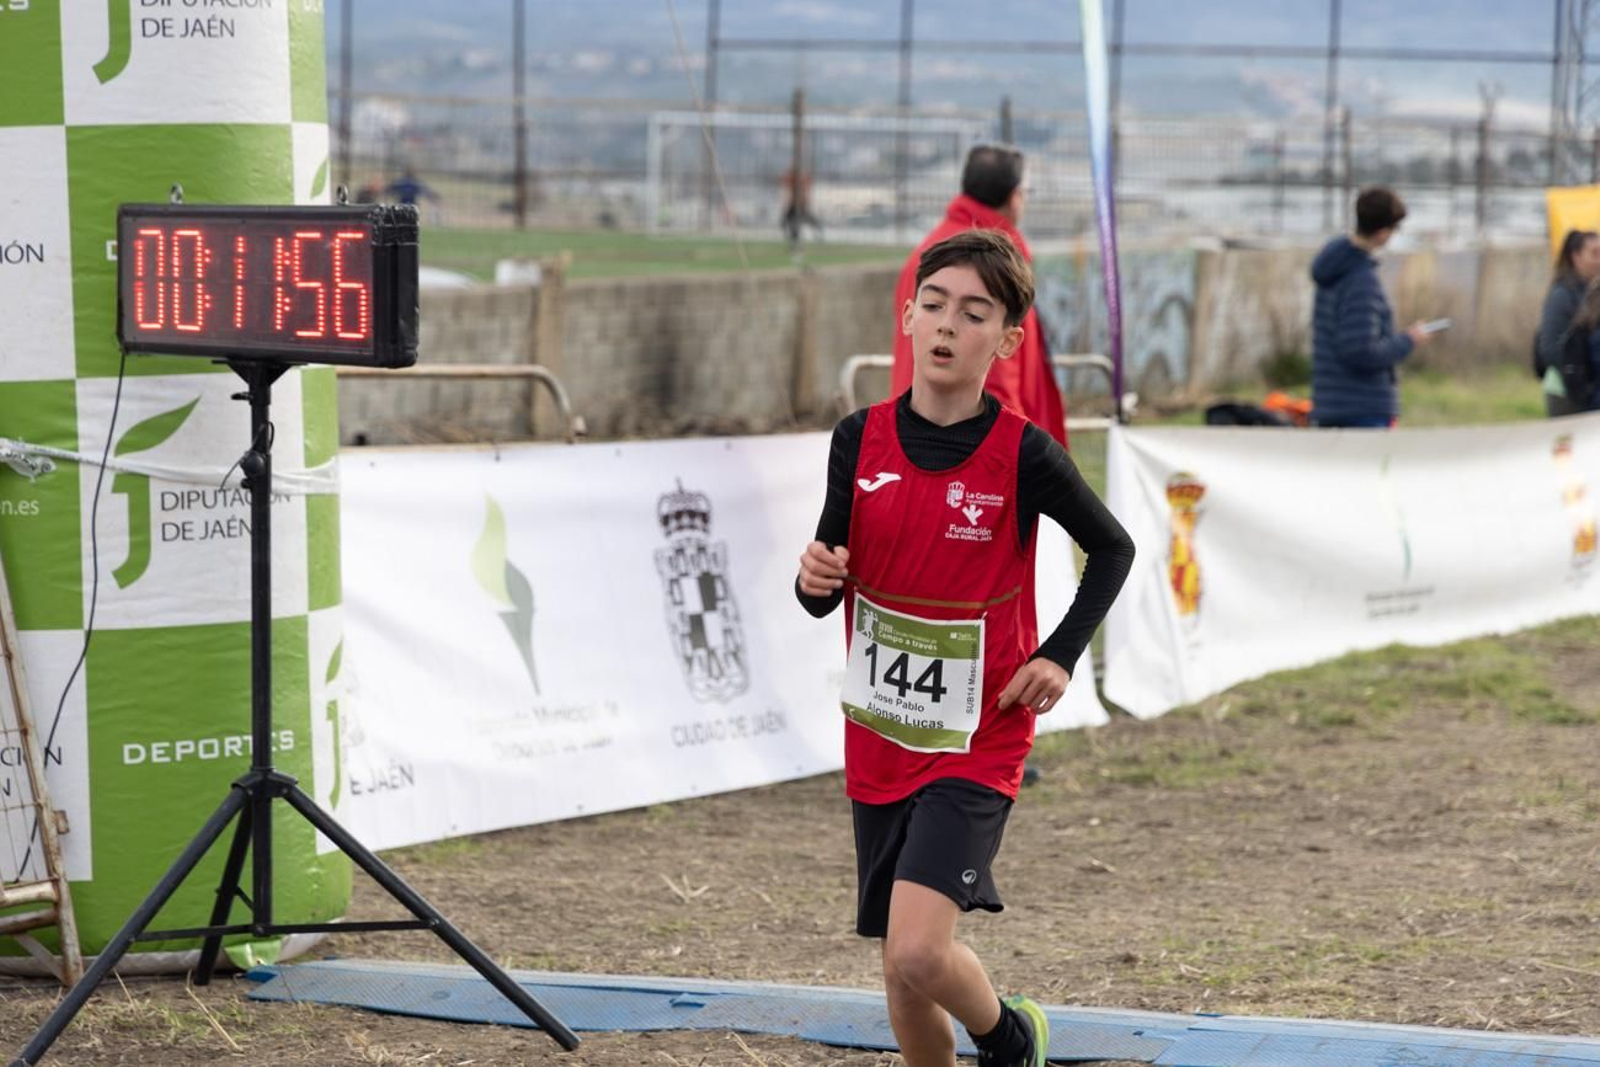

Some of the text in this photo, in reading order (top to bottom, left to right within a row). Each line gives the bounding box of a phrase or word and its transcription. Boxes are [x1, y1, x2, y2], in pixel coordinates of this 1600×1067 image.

[141, 14, 235, 38] DE JAÉN
[161, 521, 195, 542] DE
[949, 524, 992, 536] Fundación
[865, 642, 947, 703] 144
[873, 691, 925, 712] Jose Pablo
[966, 687, 975, 714] SUB14
[867, 701, 944, 729] Alonso Lucas
[122, 730, 295, 765] DEPORTS
